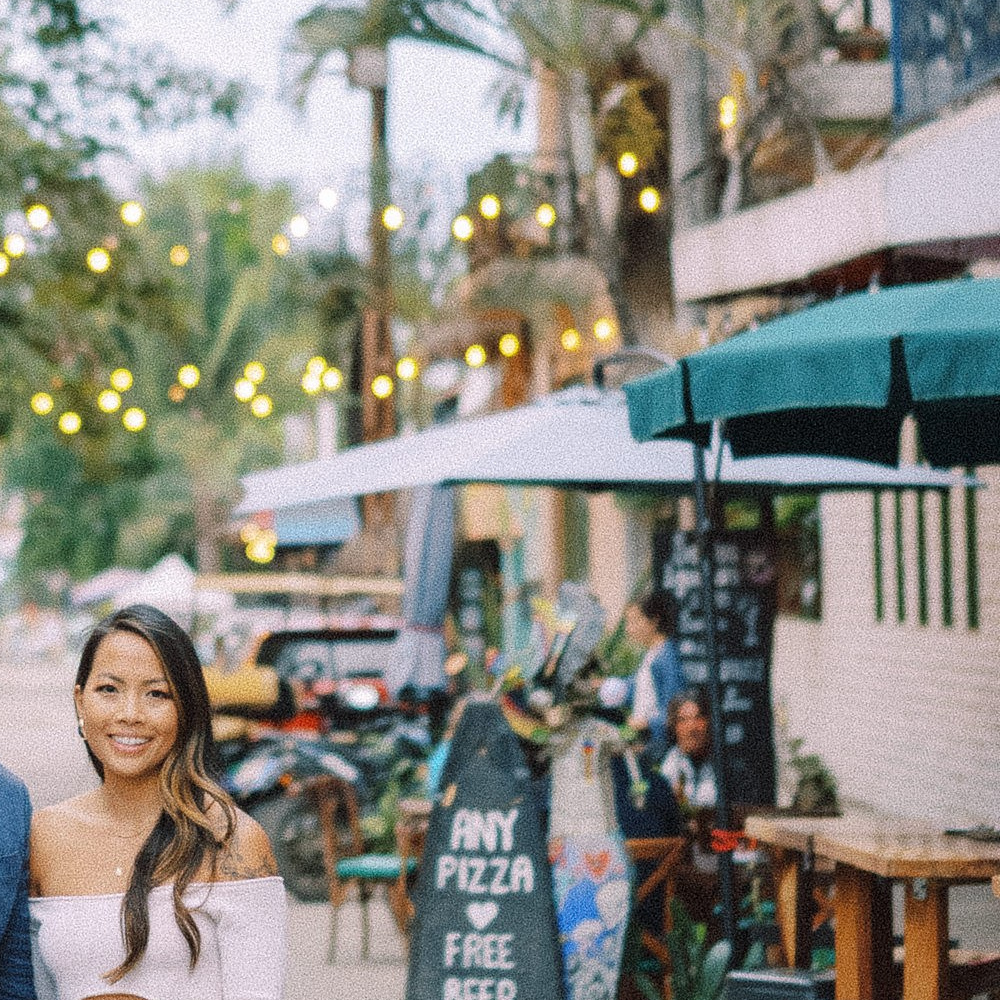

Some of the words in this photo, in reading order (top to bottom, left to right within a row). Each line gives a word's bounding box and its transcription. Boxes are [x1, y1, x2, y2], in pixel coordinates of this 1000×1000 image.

[450, 808, 518, 851] ANY
[437, 855, 534, 894] PIZZA
[445, 932, 515, 969] FREE
